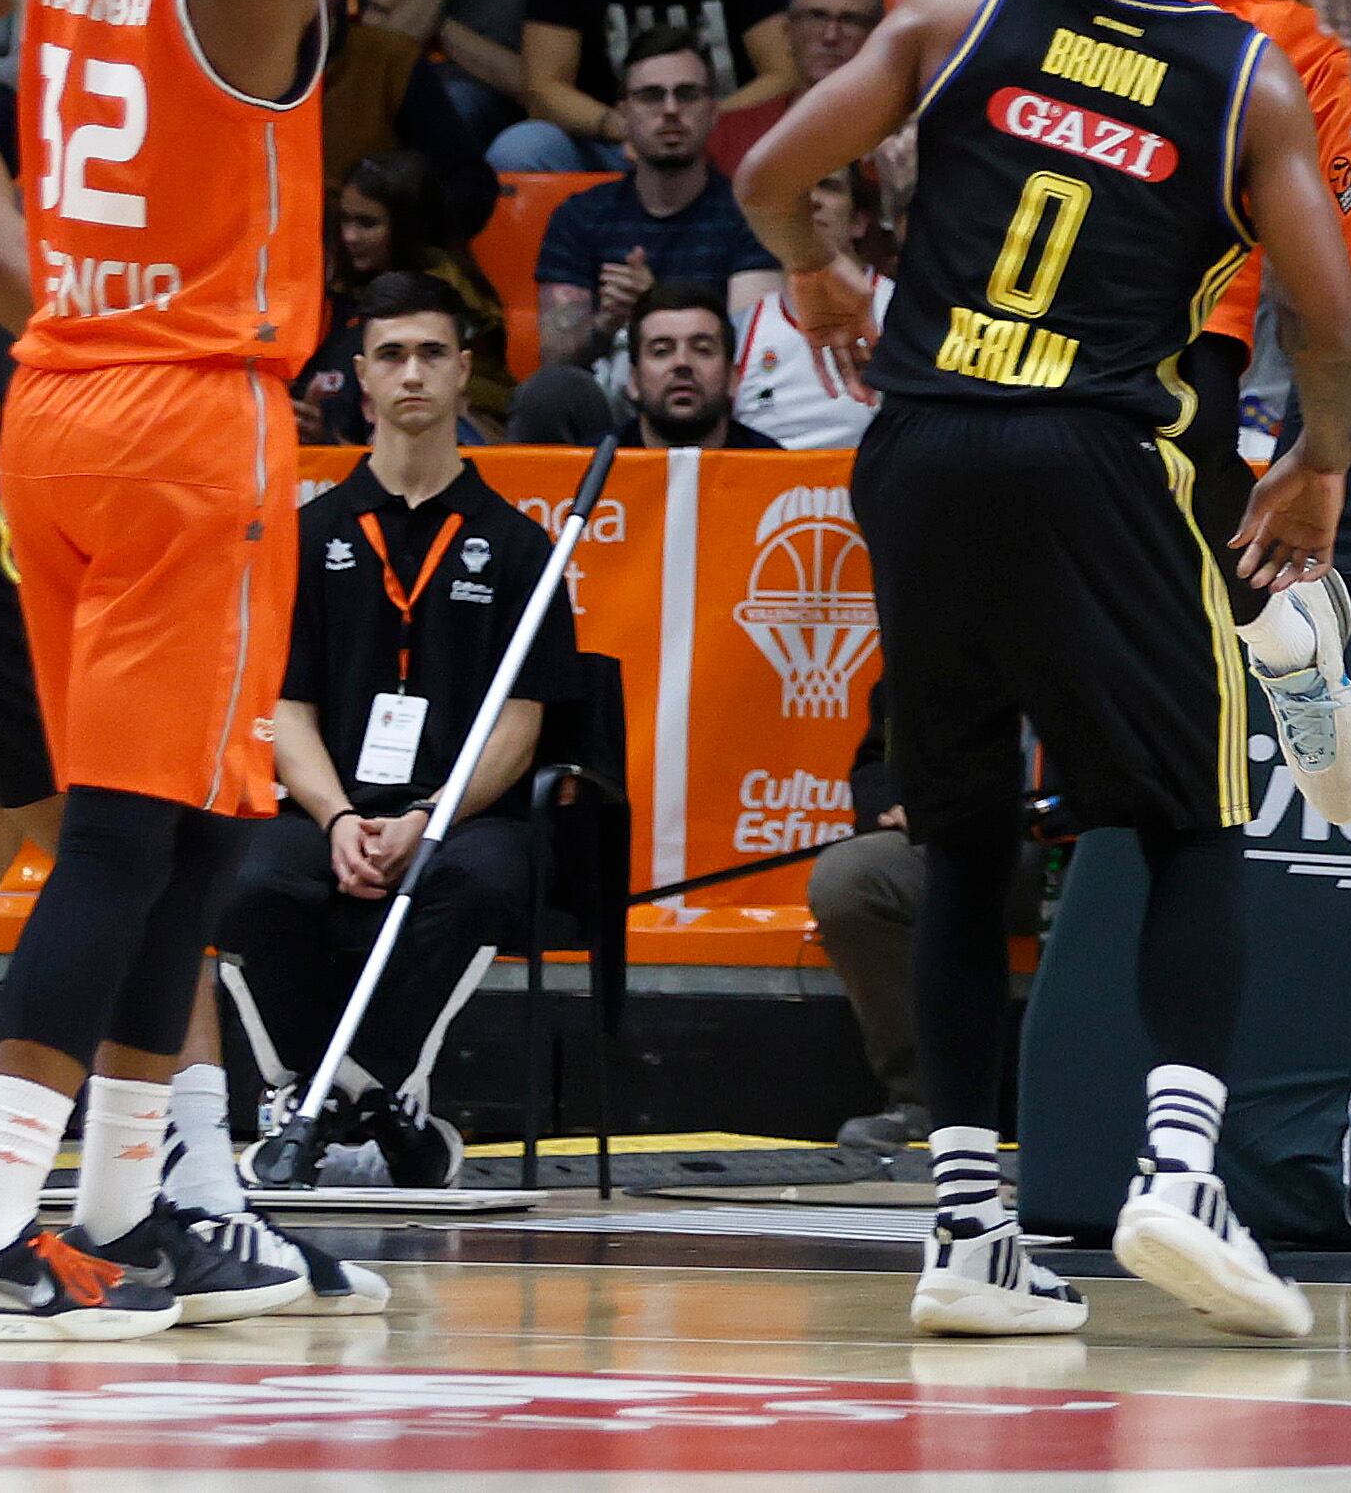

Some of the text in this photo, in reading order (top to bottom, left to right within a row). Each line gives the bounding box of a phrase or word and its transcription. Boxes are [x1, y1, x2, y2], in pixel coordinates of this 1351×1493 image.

[1041, 27, 1169, 107] BROWN
[986, 170, 1093, 319] 0
[936, 306, 1080, 389] BERLIN
